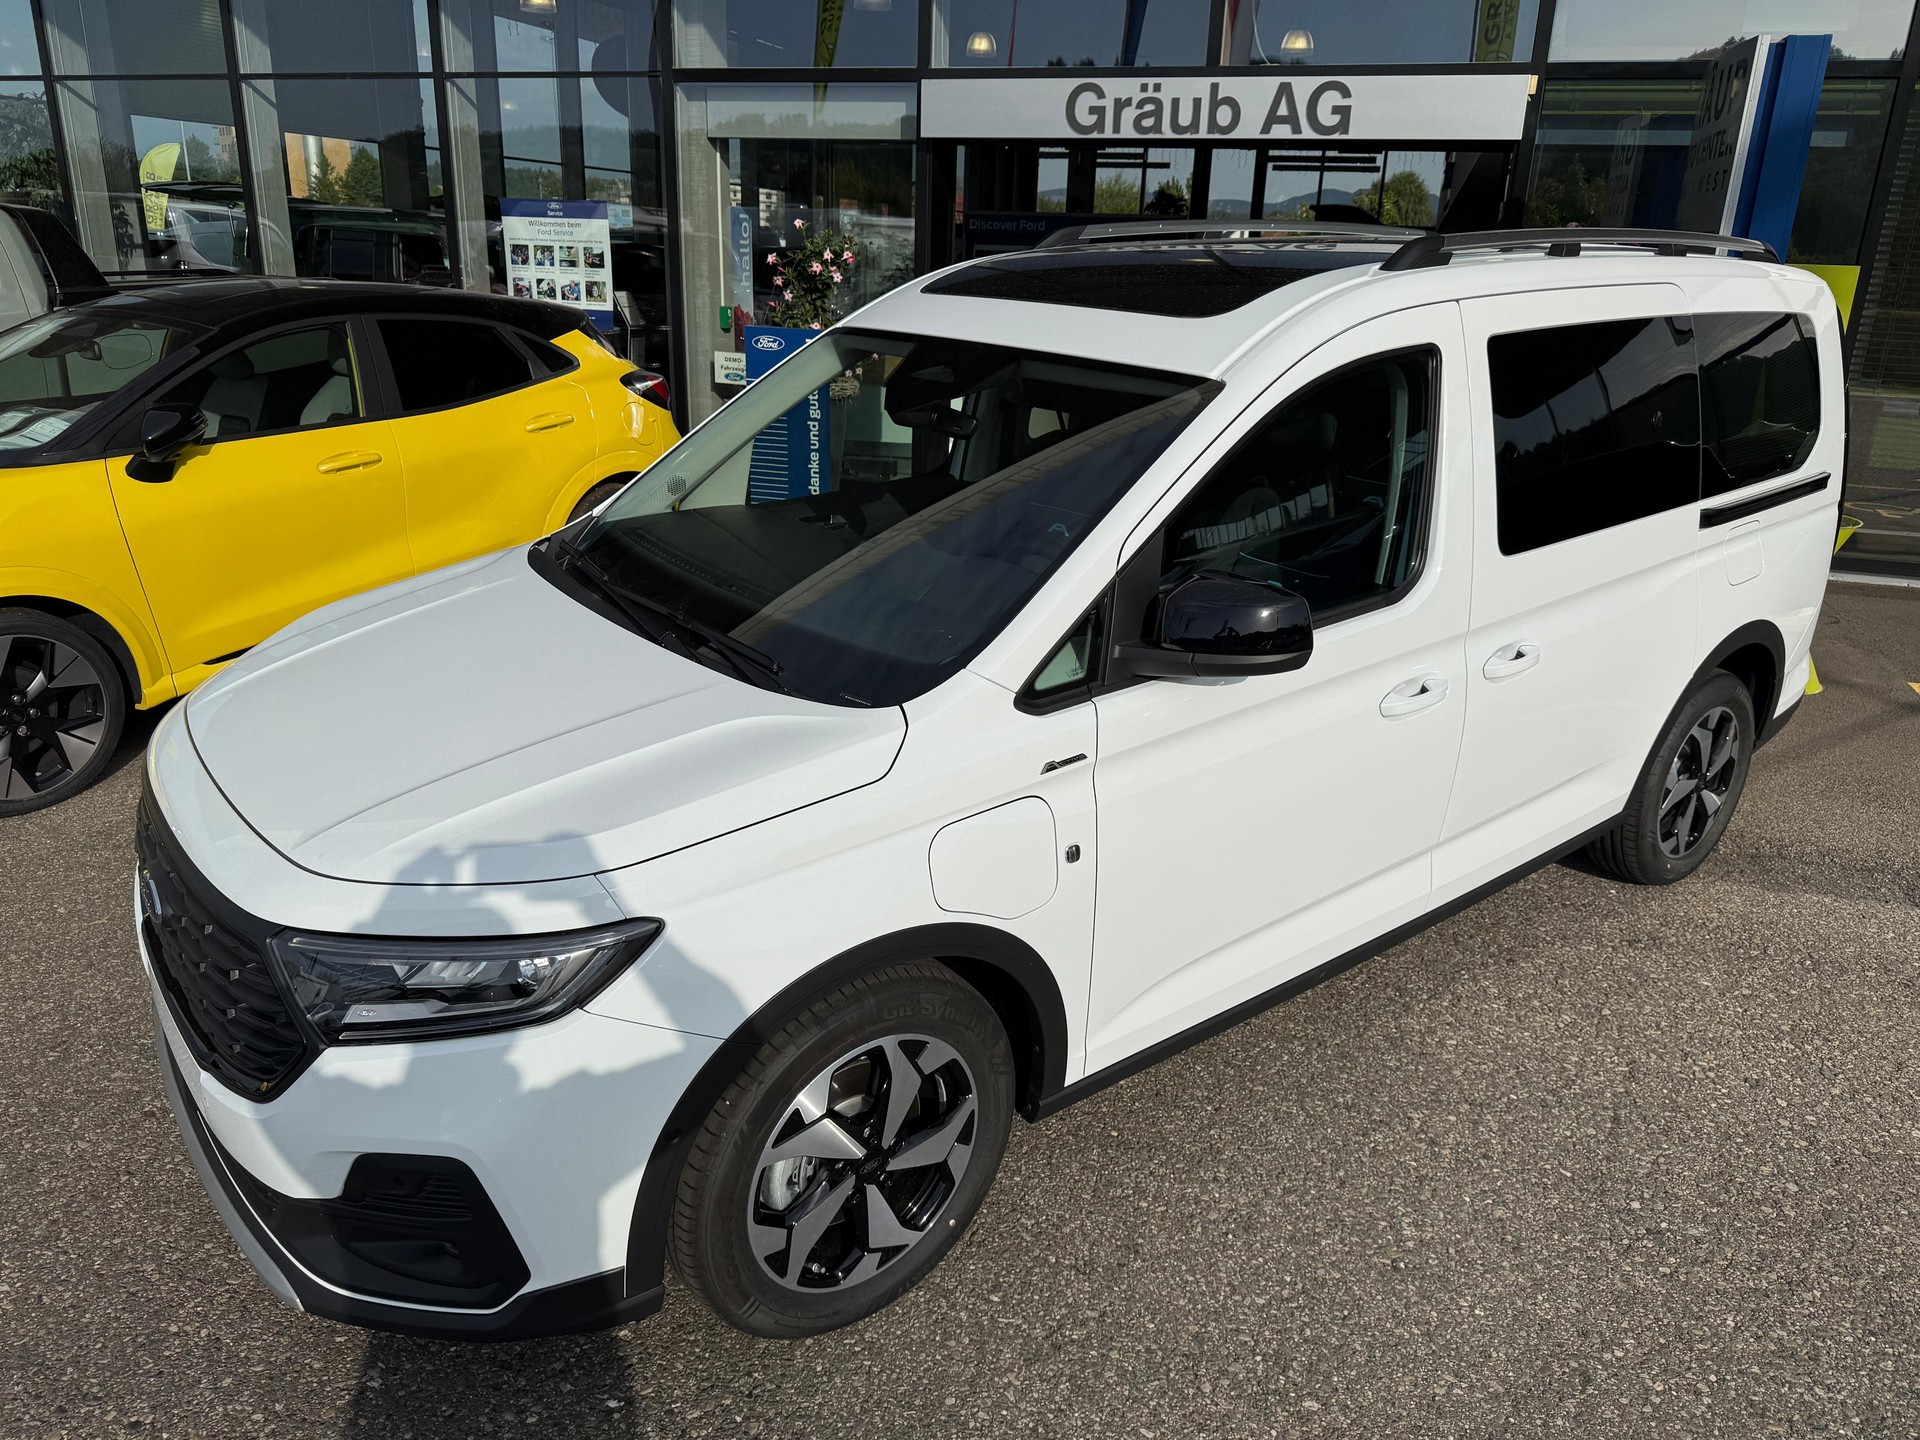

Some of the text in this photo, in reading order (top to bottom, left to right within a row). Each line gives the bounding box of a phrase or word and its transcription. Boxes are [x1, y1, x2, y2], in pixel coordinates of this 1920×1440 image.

[1065, 80, 1352, 136] Gräub AG
[528, 220, 566, 228] Willkommen
[969, 219, 1046, 231] Discover Ford
[807, 421, 819, 449] und
[808, 453, 820, 495] danke
